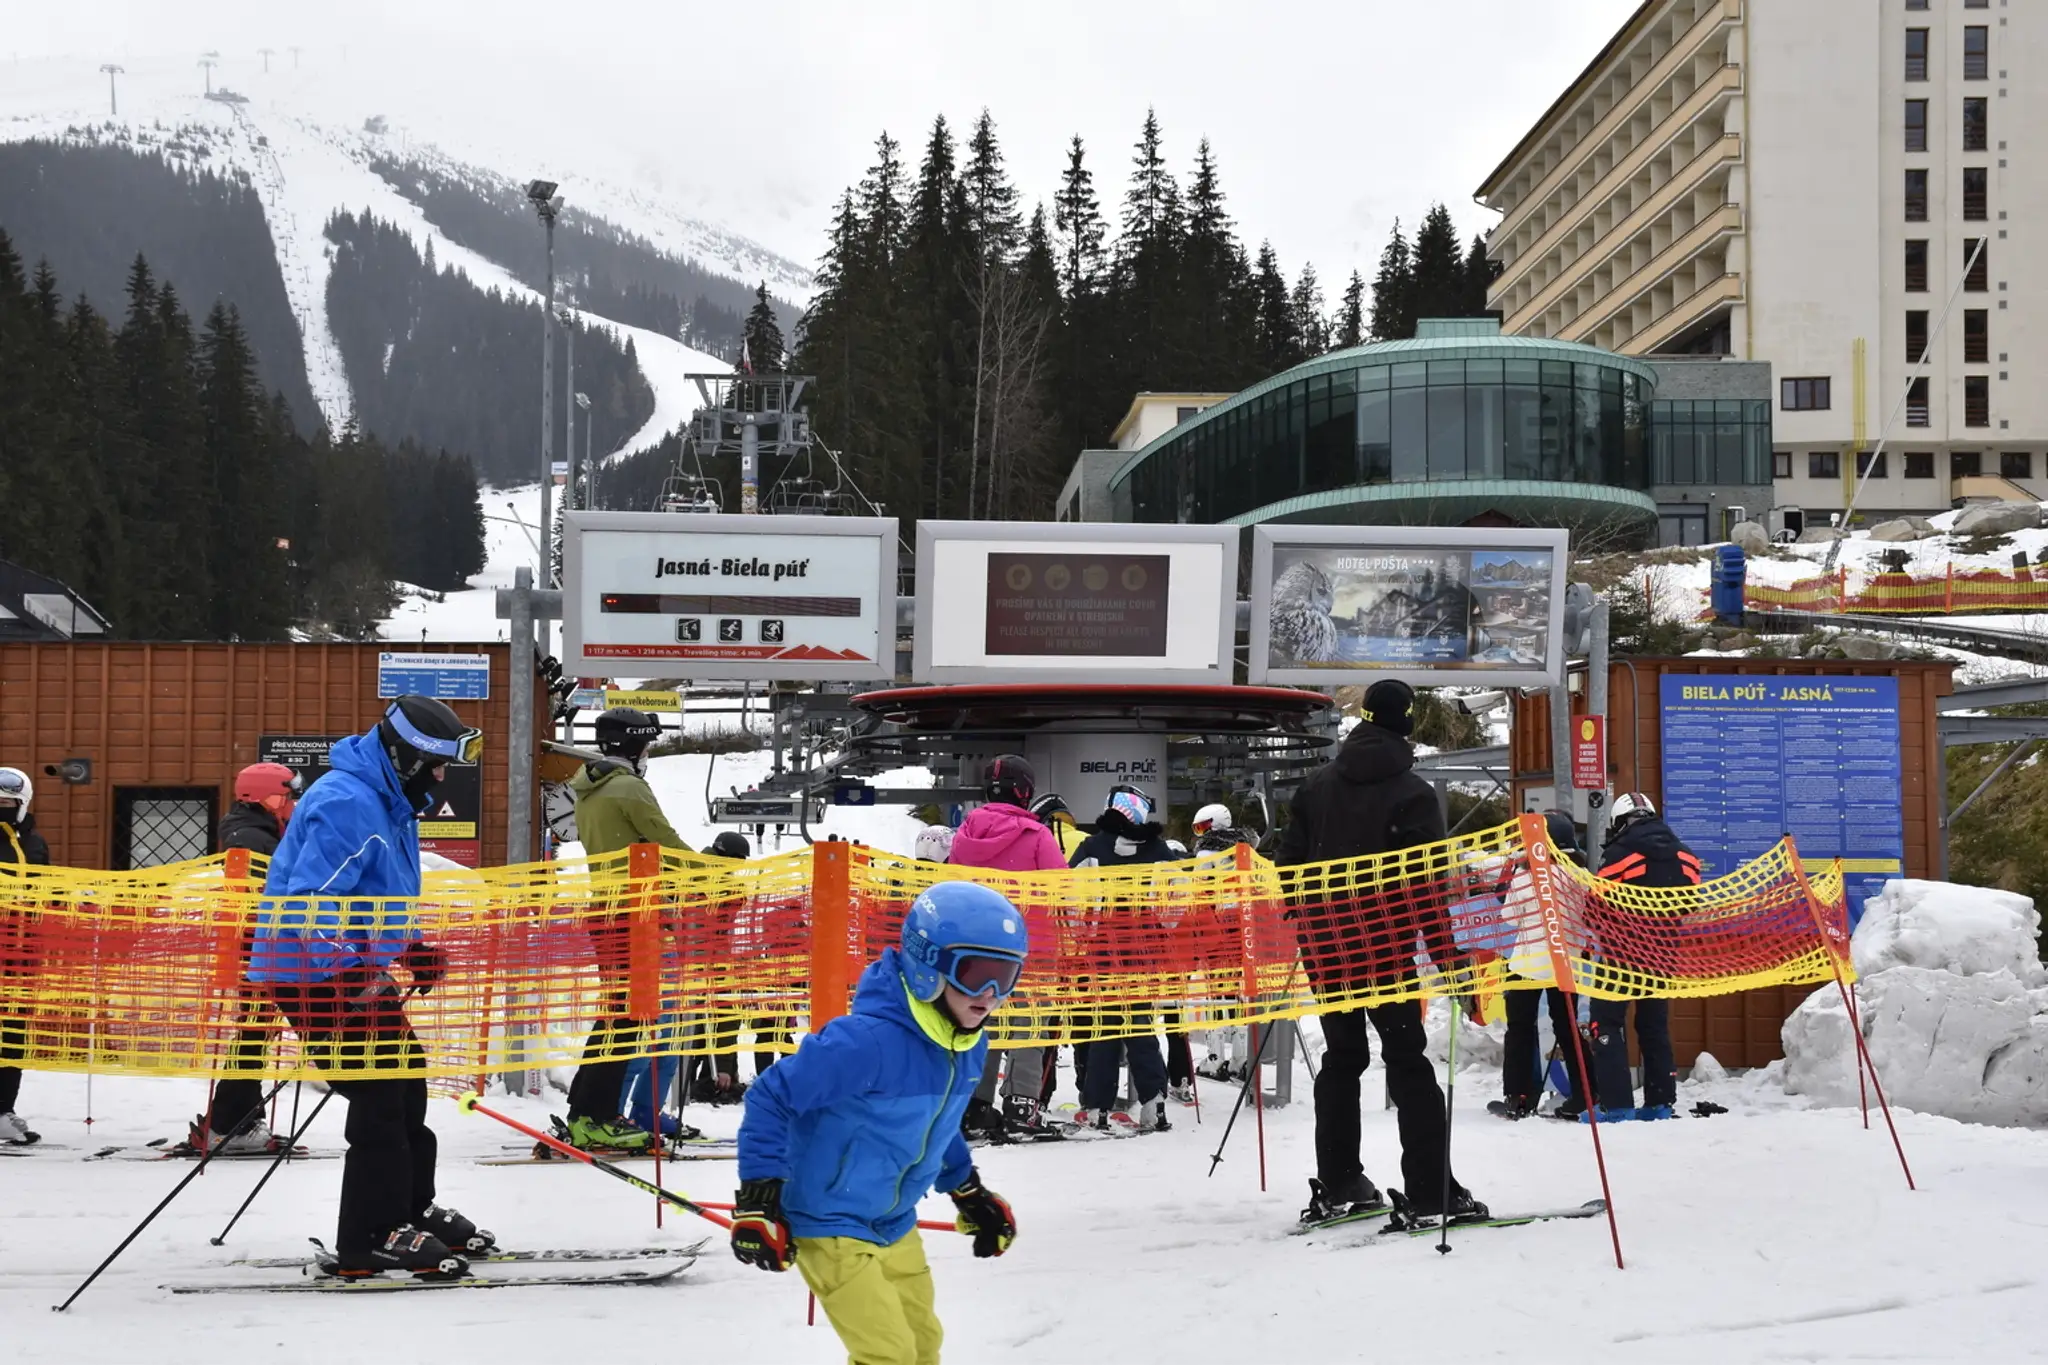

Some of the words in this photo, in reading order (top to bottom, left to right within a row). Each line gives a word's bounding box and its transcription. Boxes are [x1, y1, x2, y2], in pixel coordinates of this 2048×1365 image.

[655, 558, 711, 578] Jasná
[721, 558, 770, 577] Biela
[773, 558, 810, 581] púť
[1337, 557, 1372, 570] HOTEL
[1374, 555, 1409, 570] POŠTA
[684, 649, 719, 657] Travelling
[1682, 686, 1730, 700] BIELA
[1734, 683, 1766, 700] PÚŤ
[1780, 684, 1833, 701] JASNÁ
[1080, 761, 1127, 773] BIELA
[1131, 758, 1157, 773] PÚŤ
[1535, 866, 1566, 956] marabut
